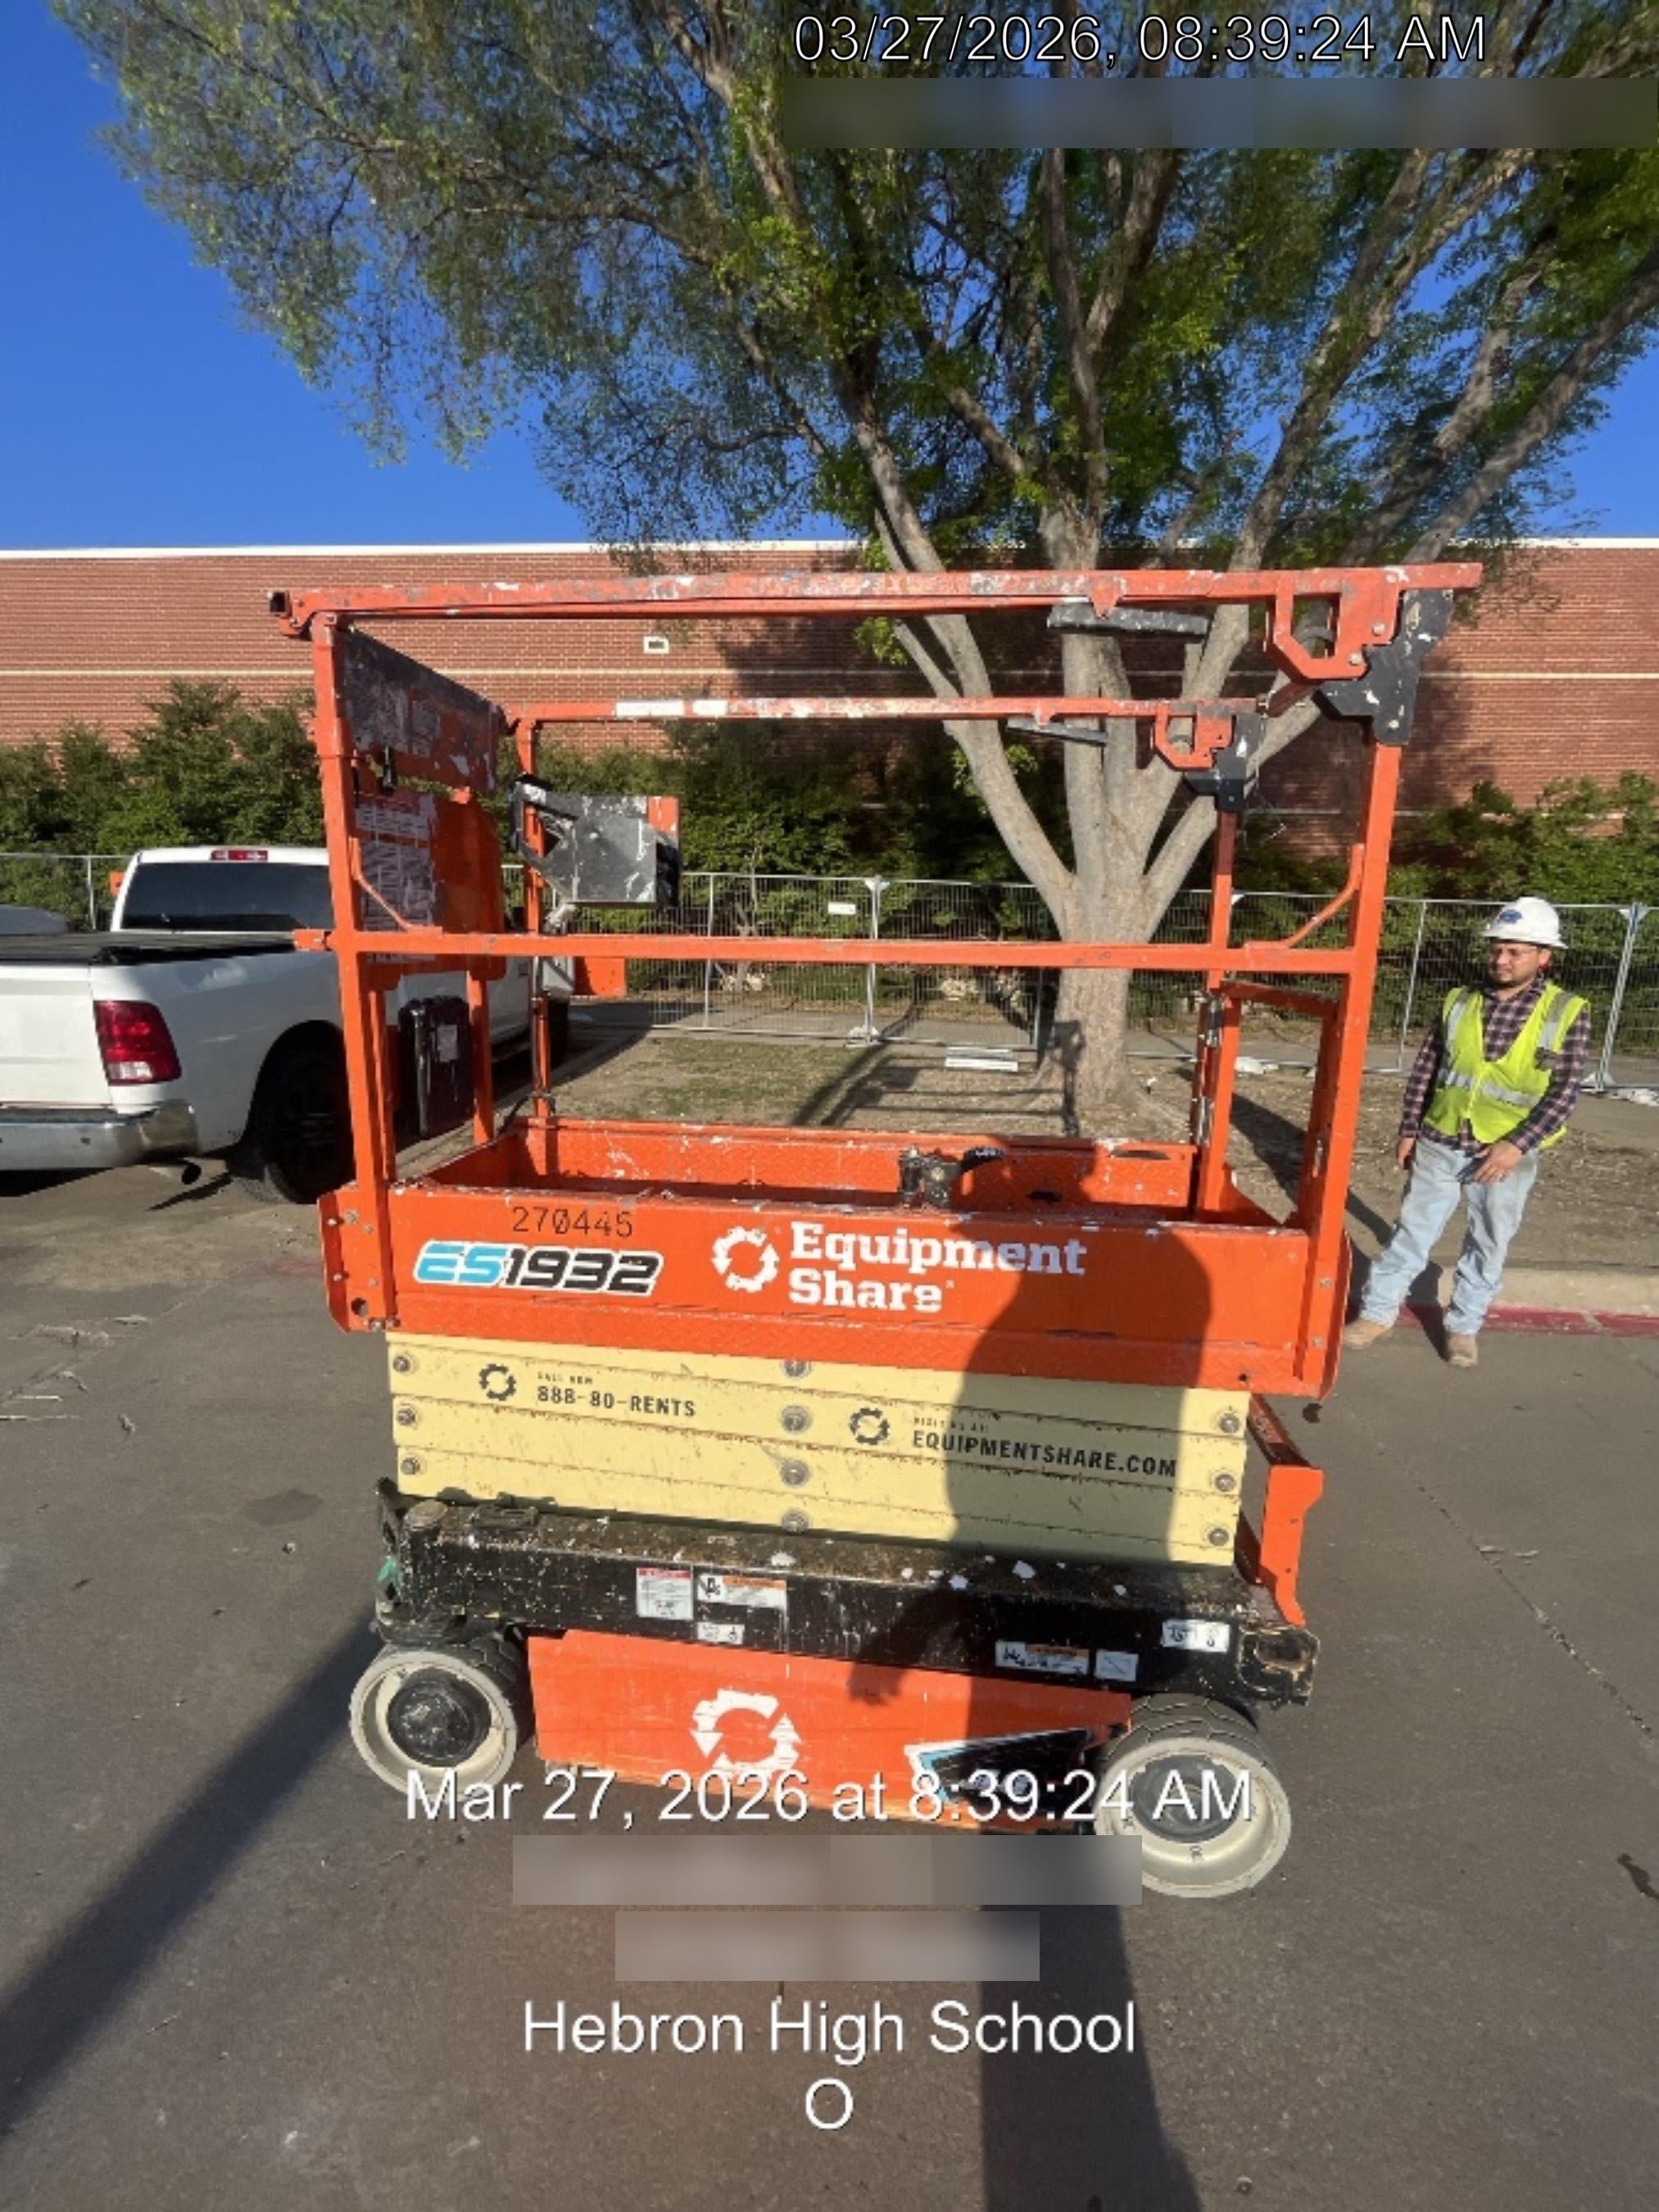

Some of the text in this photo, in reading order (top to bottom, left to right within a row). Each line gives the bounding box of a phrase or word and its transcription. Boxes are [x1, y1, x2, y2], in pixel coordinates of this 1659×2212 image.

[511, 1206, 633, 1238] 270445
[414, 1240, 661, 1294] ES1932
[790, 1221, 1088, 1276] Equipment
[537, 1385, 696, 1417] 888-80-RENTS
[912, 1429, 1177, 1478] EQUIPMENTSHARE.COM
